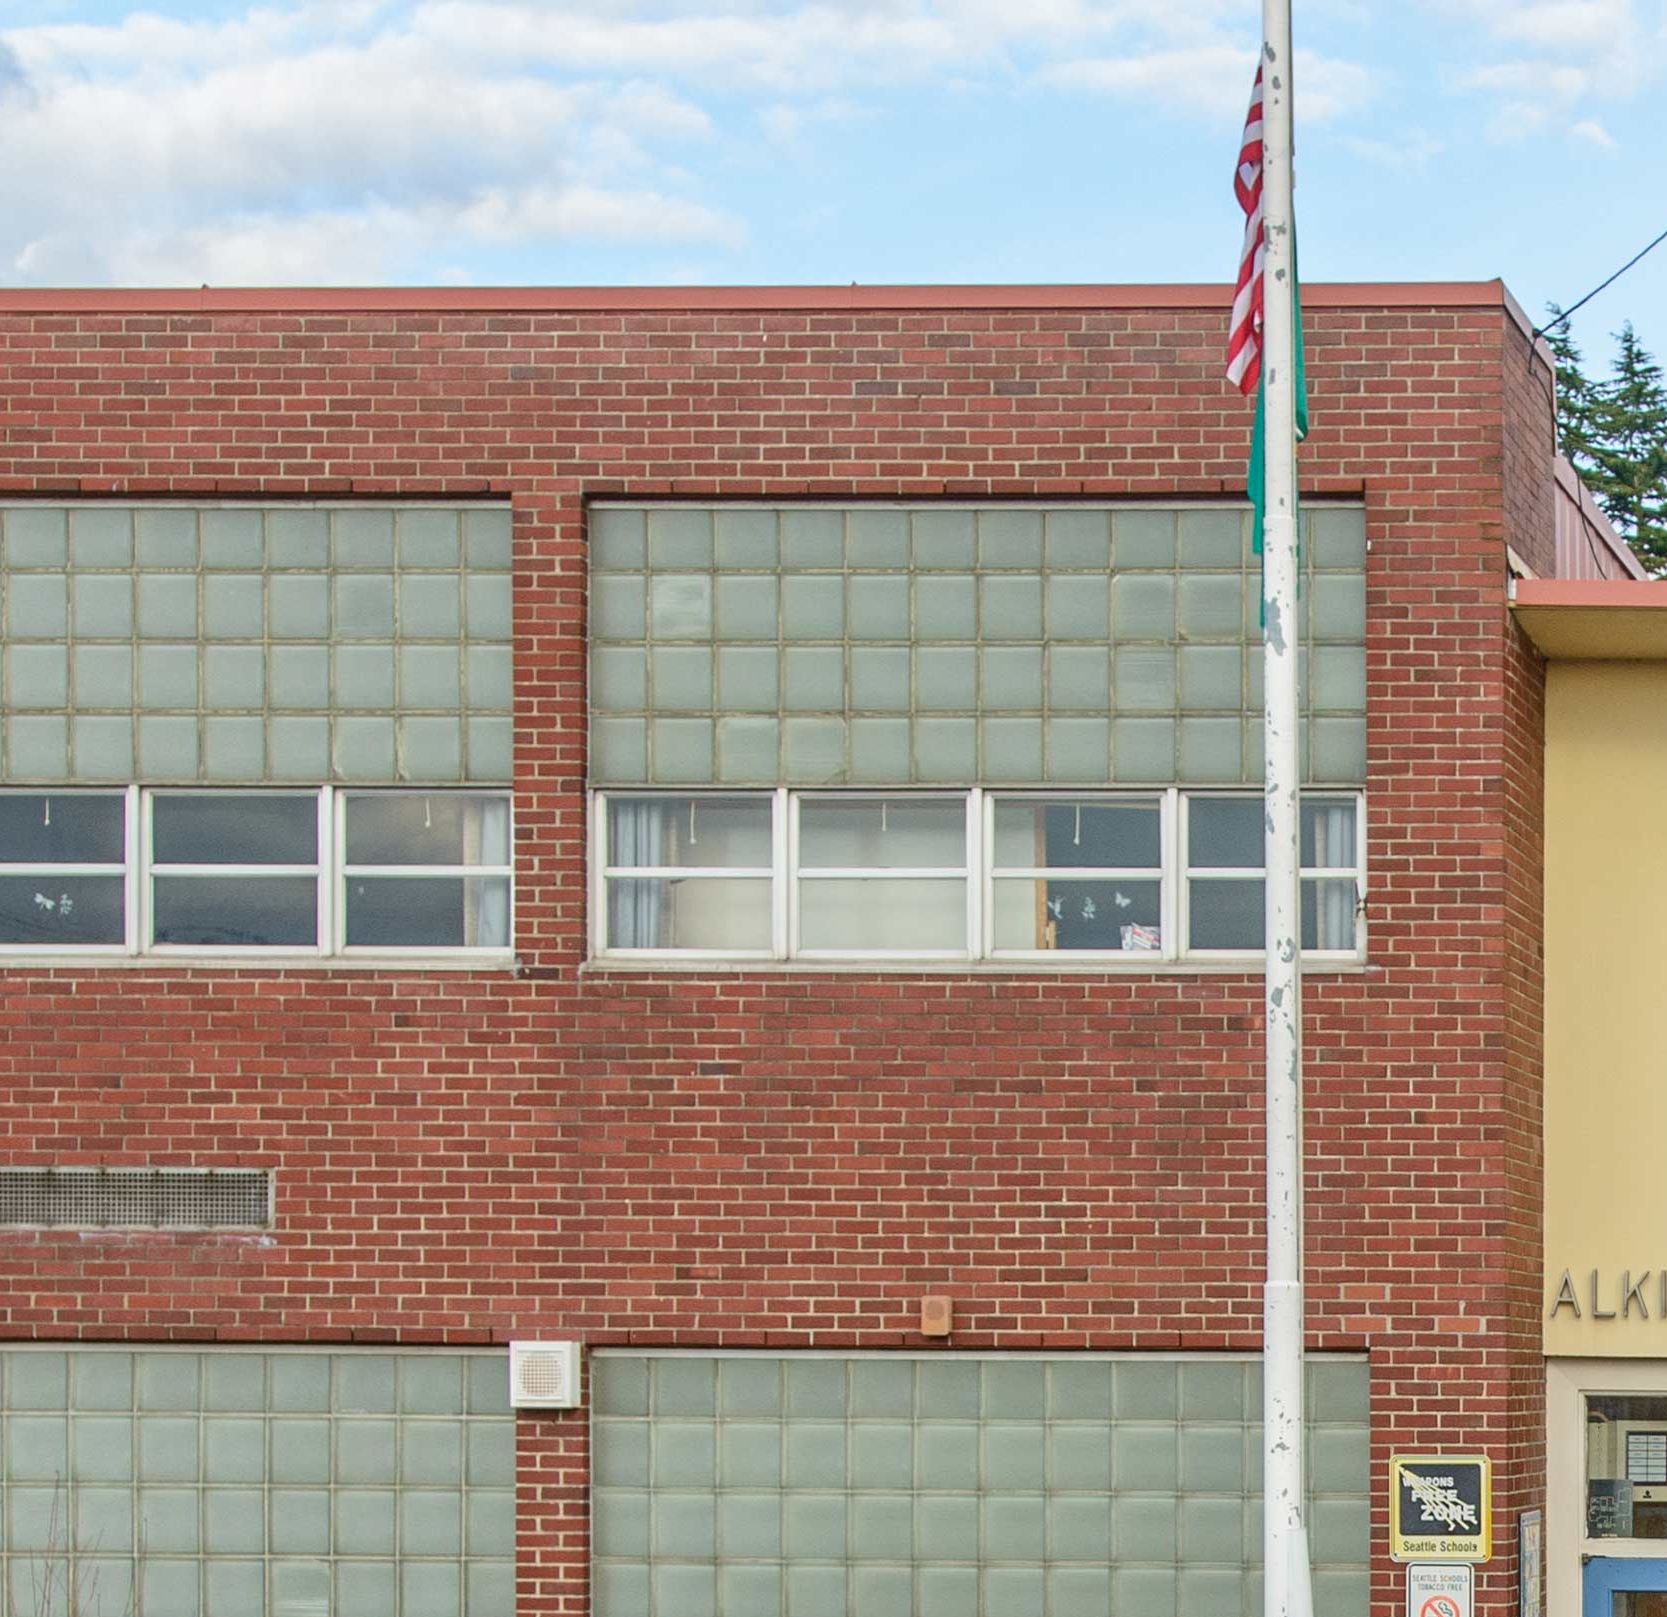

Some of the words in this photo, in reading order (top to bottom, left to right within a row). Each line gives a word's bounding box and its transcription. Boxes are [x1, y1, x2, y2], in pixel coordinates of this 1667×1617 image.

[1550, 1268, 1667, 1319] ALKI
[1403, 1541, 1436, 1552] Seattle
[1440, 1541, 1478, 1552] Schools
[1413, 1574, 1437, 1582] SEATTLE
[1440, 1574, 1468, 1582] SCHOOLS
[1418, 1583, 1445, 1591] TOBACCO
[1447, 1583, 1463, 1591] FREE
